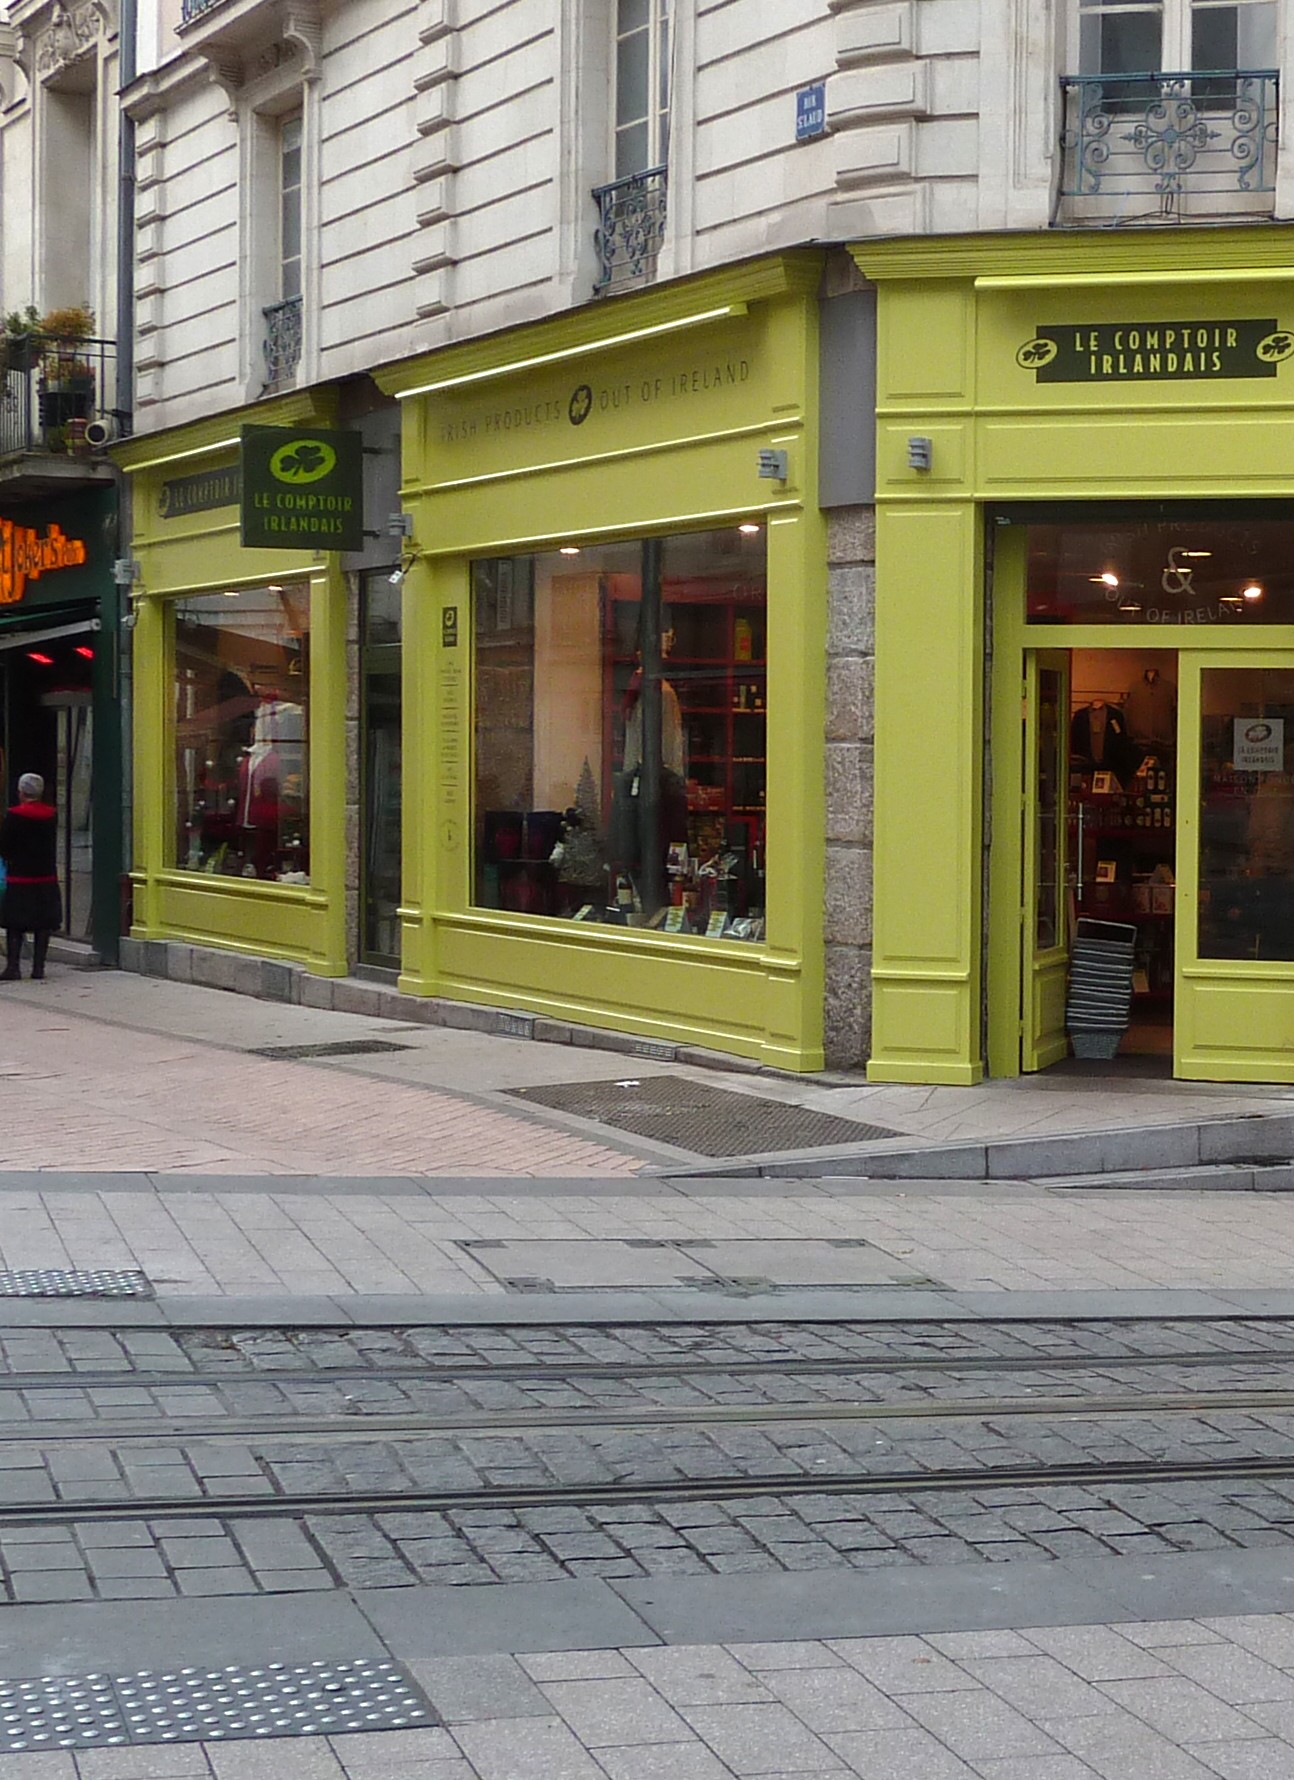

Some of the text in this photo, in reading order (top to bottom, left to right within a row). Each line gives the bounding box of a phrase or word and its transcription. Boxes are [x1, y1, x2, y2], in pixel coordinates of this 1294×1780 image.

[1075, 328, 1238, 351] LE COMPTOIR
[1090, 351, 1222, 374] IRLANDAIS
[601, 360, 749, 409] OUT OF IRELAND
[485, 401, 561, 433] PRODUCTS
[254, 493, 352, 511] LE COMPTOIR
[264, 516, 344, 533] IRLANDAIS
